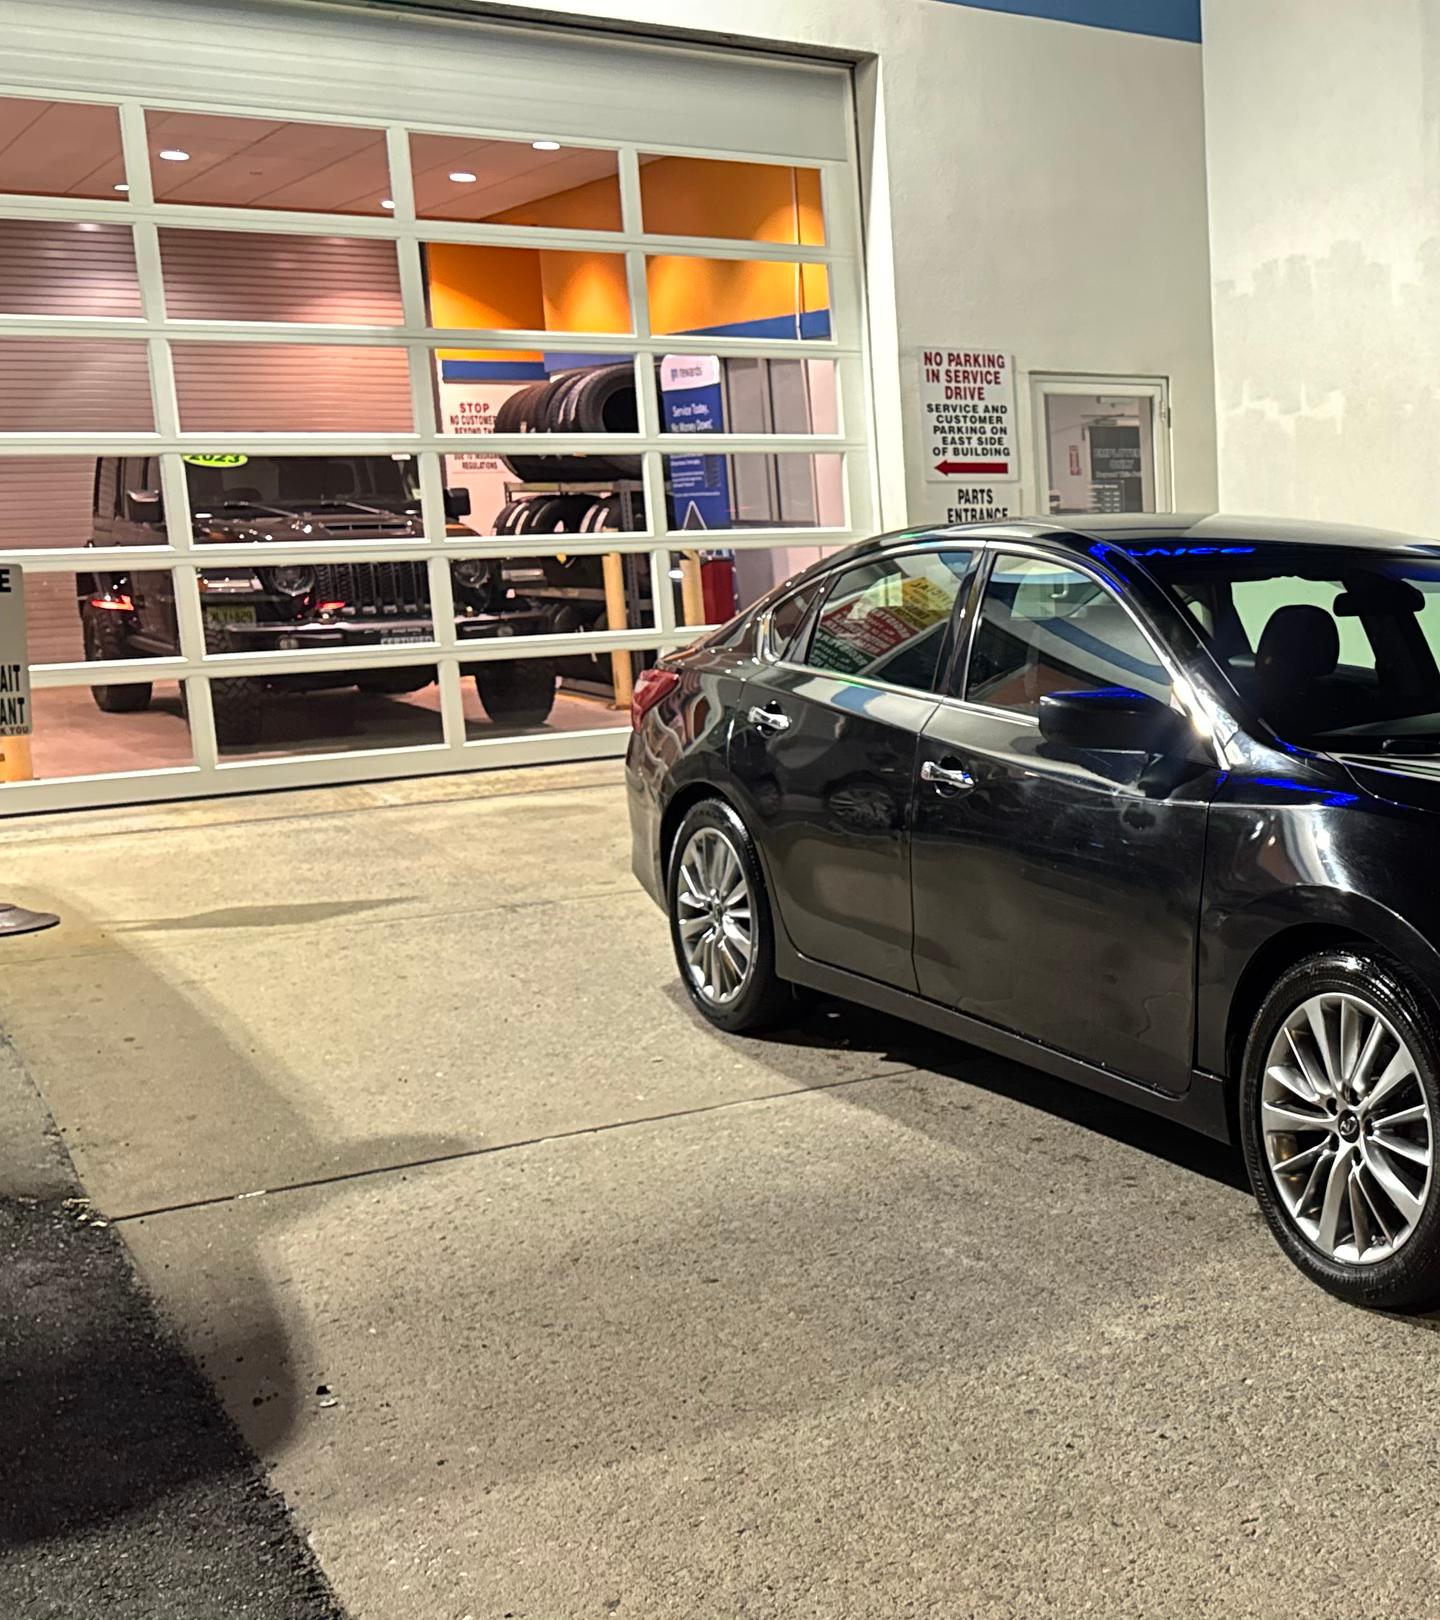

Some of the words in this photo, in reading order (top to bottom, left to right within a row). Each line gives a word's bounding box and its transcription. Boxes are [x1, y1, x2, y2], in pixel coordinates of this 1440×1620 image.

[923, 351, 943, 367] NO
[947, 352, 1005, 369] PARKING
[926, 368, 940, 383] IN
[944, 369, 1001, 385] SERVICE
[945, 386, 985, 401] DRIVE
[460, 402, 490, 413] STOP
[926, 403, 979, 414] SERVICE
[983, 404, 1008, 414] AND
[450, 415, 459, 425] NO
[936, 414, 1003, 425] CUSTOMER
[933, 425, 986, 435] PARKING
[990, 426, 1008, 435] ON
[941, 436, 973, 446] EAST
[977, 436, 1004, 446] SIDE
[932, 446, 948, 456] OF
[952, 447, 1010, 456] BUILDING
[957, 488, 994, 505] PARTS
[947, 507, 1008, 523] ENTRANCE
[10, 725, 29, 736] YOU
